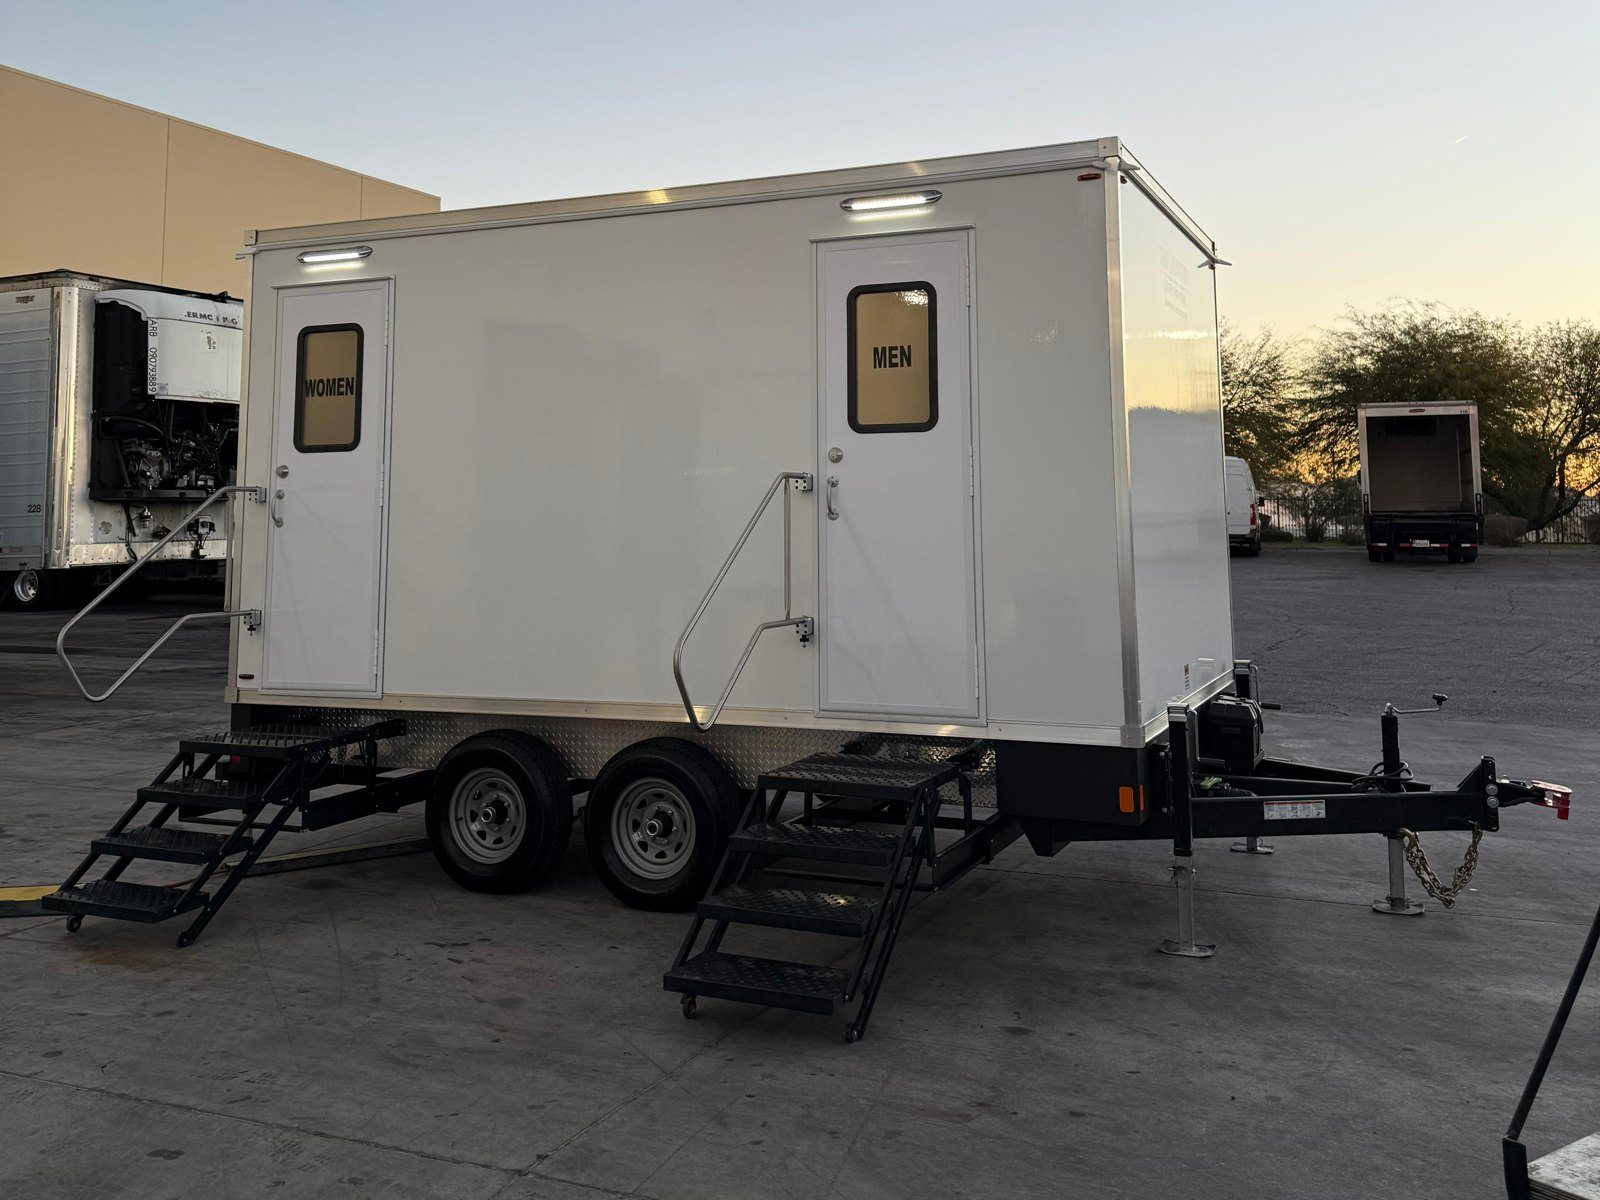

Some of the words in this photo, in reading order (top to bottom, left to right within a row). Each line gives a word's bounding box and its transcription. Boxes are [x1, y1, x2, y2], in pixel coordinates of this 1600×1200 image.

[149, 318, 158, 337] ARB
[873, 345, 911, 368] MEN
[304, 377, 355, 398] WOMEN
[28, 504, 41, 513] 228
